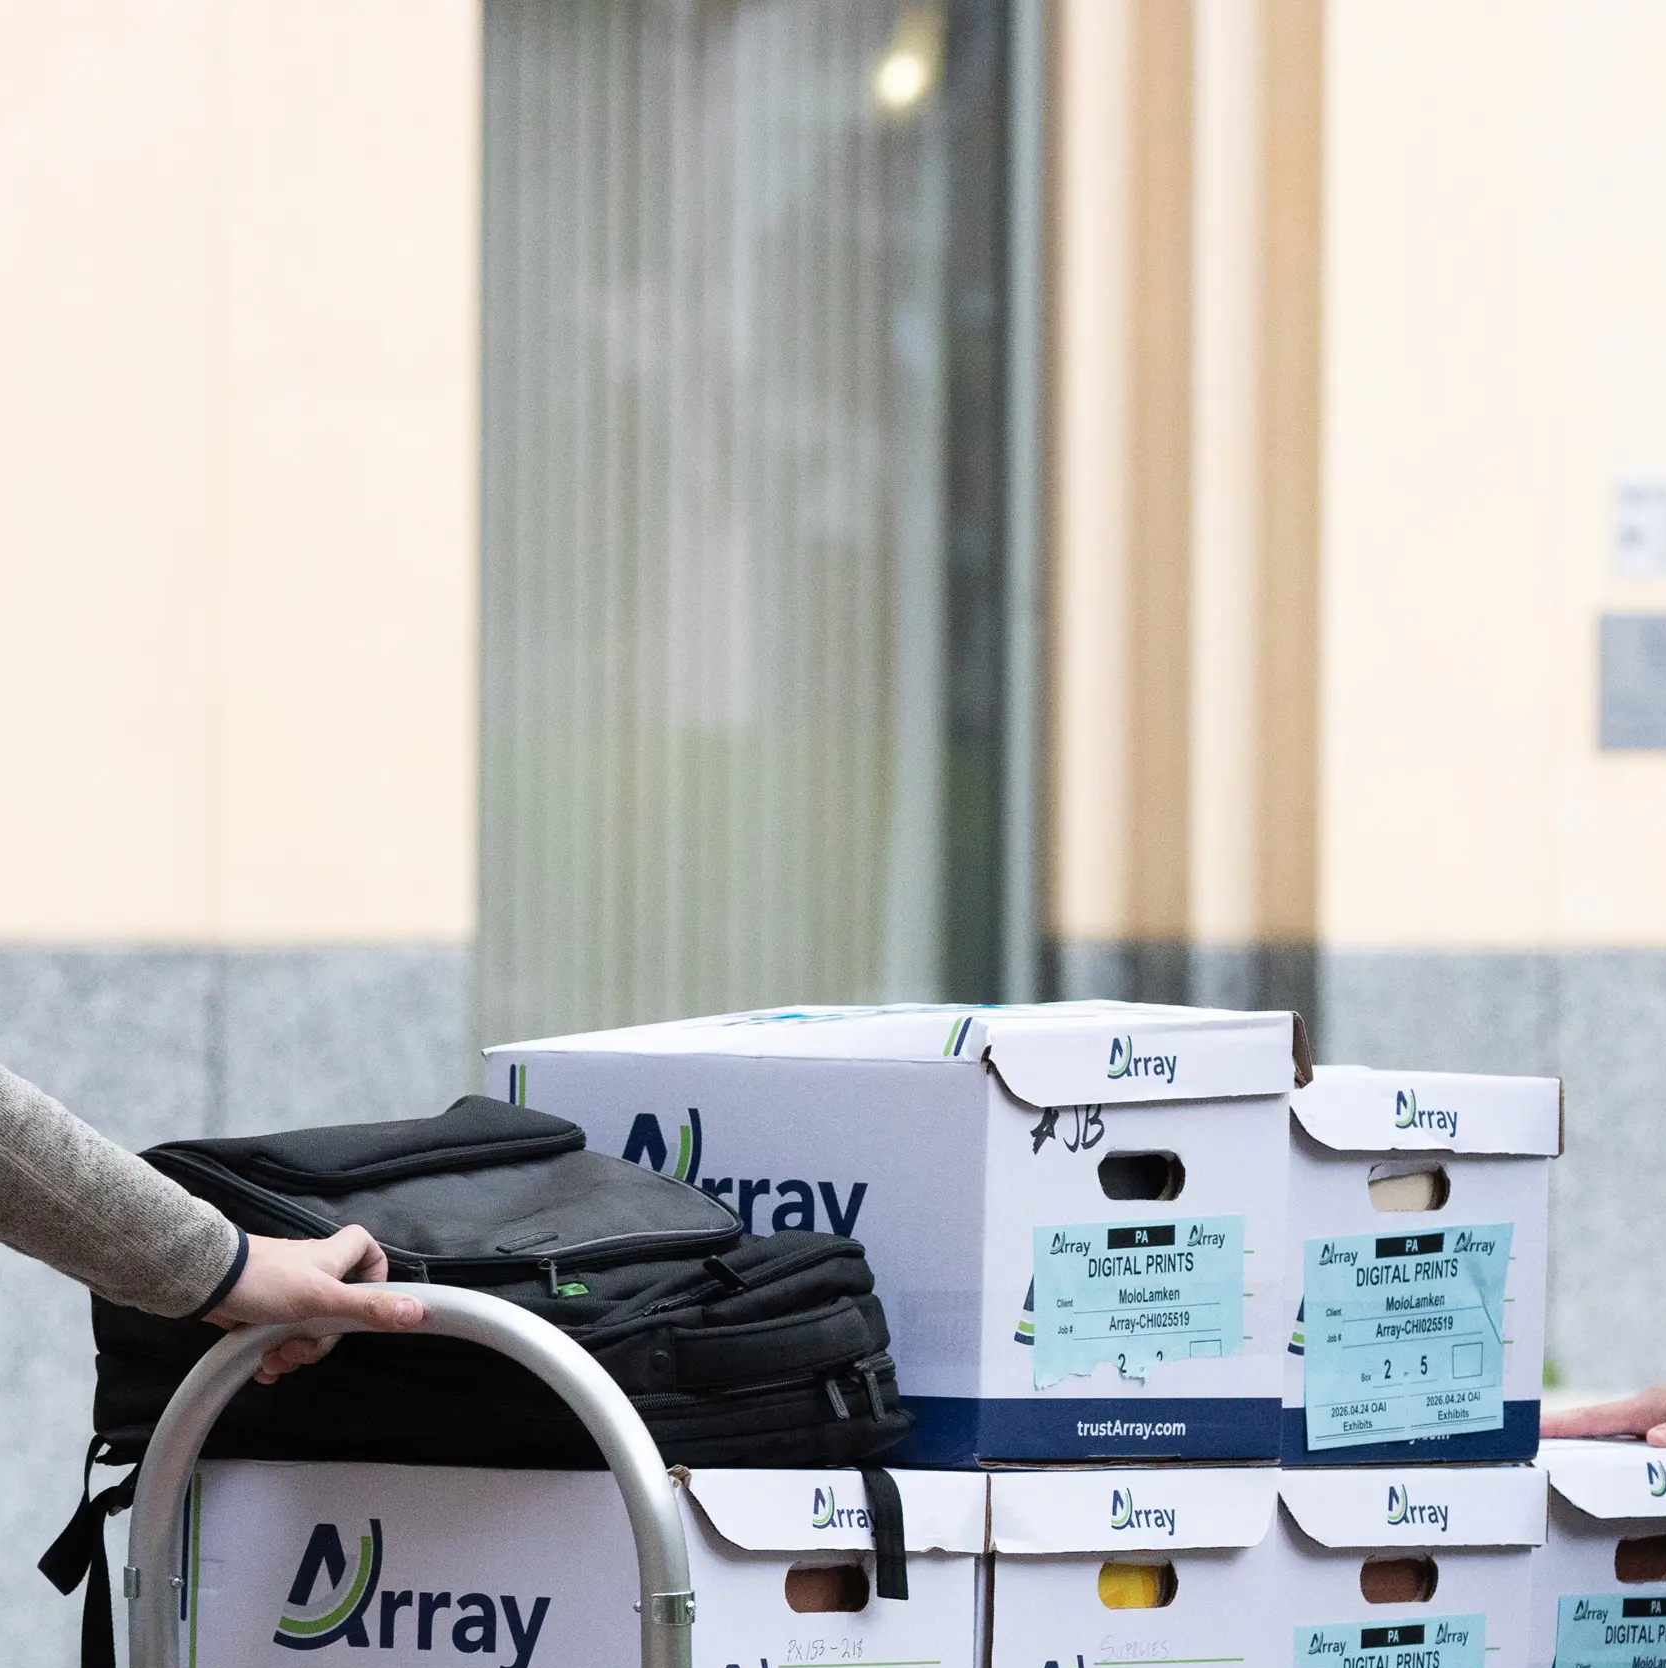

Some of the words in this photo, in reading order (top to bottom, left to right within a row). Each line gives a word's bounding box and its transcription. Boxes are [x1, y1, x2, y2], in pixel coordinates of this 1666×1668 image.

[1107, 1035, 1177, 1084] Array
[1395, 1088, 1458, 1138] Array
[1135, 1230, 1149, 1243] PA
[1405, 1239, 1419, 1252] PA
[1088, 1256, 1142, 1278] DIGITAL
[1146, 1252, 1194, 1274] PRINTS
[1356, 1264, 1410, 1287] DIGITAL
[1415, 1258, 1458, 1282] PRINTS
[1119, 1288, 1180, 1304] MoloLamken
[1386, 1293, 1445, 1312] MoloLamken
[1109, 1311, 1190, 1333] Array-CHI025519
[1376, 1316, 1453, 1339] Array-CHI025519
[1384, 1359, 1391, 1379] 2
[1420, 1355, 1428, 1375] 5
[1077, 1420, 1186, 1440] trustArray.com
[1111, 1487, 1175, 1536] Array
[1387, 1484, 1449, 1532] Array
[1651, 1601, 1662, 1614] PA
[1388, 1629, 1399, 1643] PA
[1605, 1625, 1654, 1645] DIGITAL
